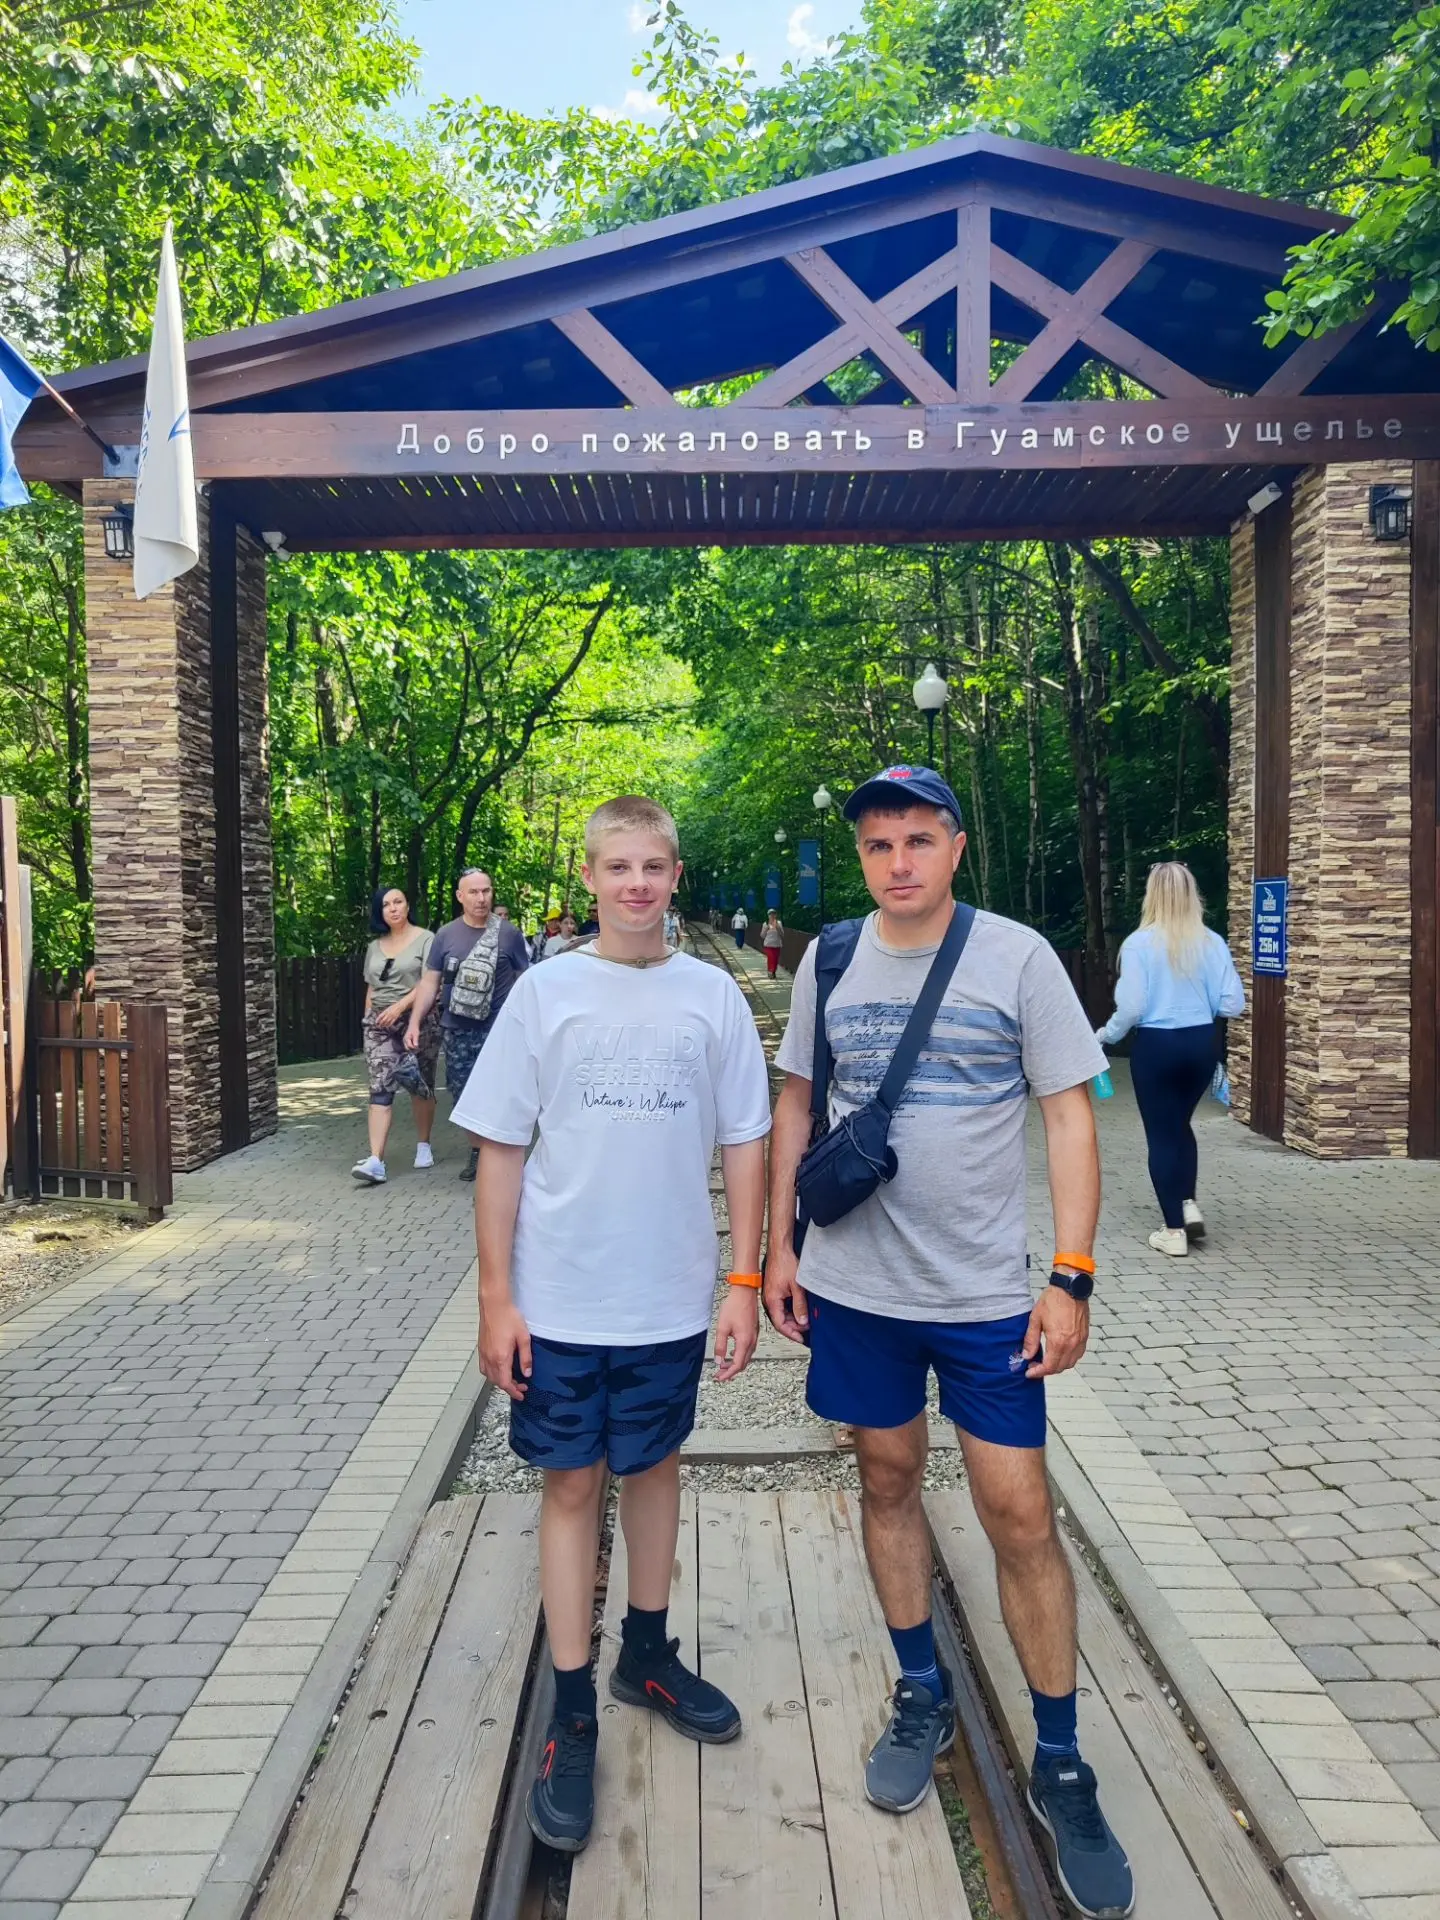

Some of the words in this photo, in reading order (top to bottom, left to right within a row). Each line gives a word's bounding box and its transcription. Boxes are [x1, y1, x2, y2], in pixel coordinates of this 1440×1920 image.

[396, 423, 550, 460] Добро
[581, 429, 872, 453] пожаловать
[907, 428, 925, 449] в
[956, 421, 1191, 456] Гуамское
[1224, 418, 1403, 449] ущелье
[572, 1024, 703, 1062] WILD
[575, 1064, 700, 1087] SERENITY
[580, 1085, 635, 1110] Nature's
[639, 1088, 689, 1116] Whisper
[610, 1110, 668, 1122] UNTAMED
